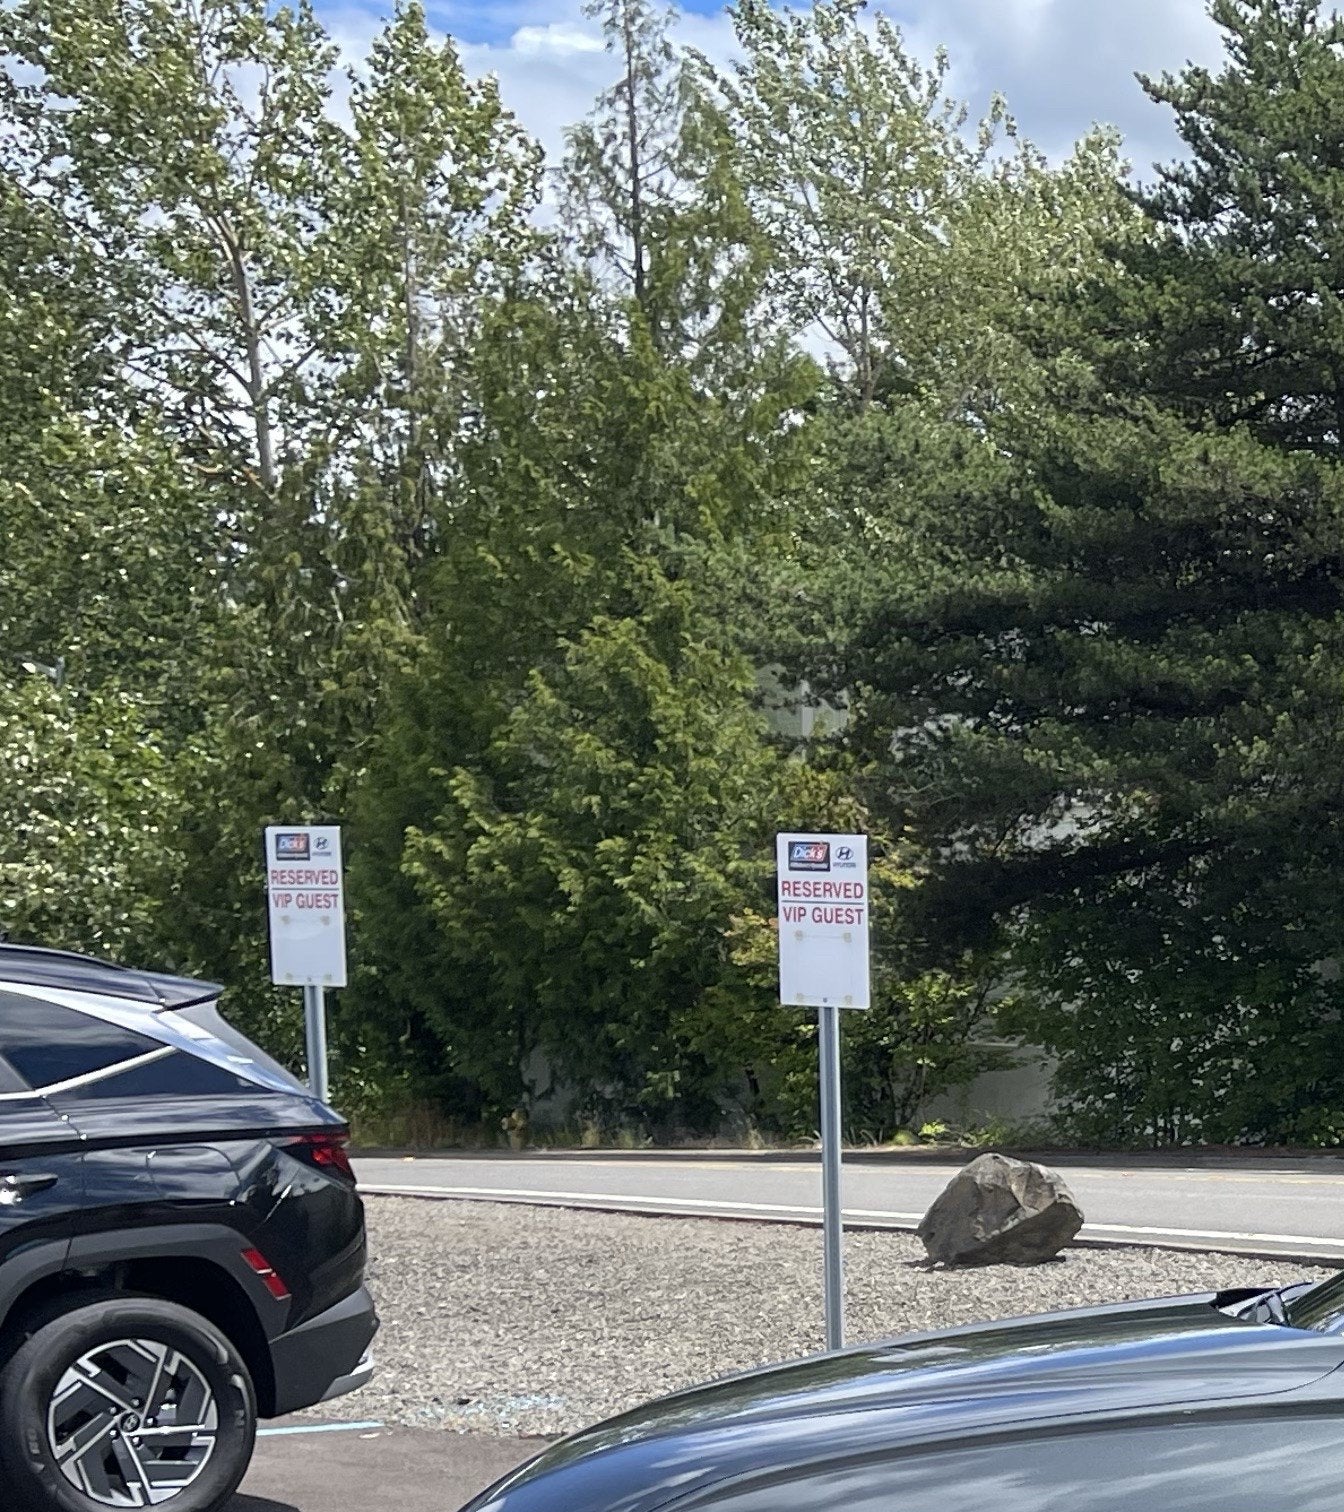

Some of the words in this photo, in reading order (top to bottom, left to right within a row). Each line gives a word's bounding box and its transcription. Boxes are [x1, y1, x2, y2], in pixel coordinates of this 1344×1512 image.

[271, 870, 339, 885] RESERVED
[781, 881, 864, 899] RESERVED
[272, 894, 292, 908] VIP
[296, 894, 338, 909] GUEST
[783, 907, 807, 922] VIP
[812, 908, 864, 924] GUEST
